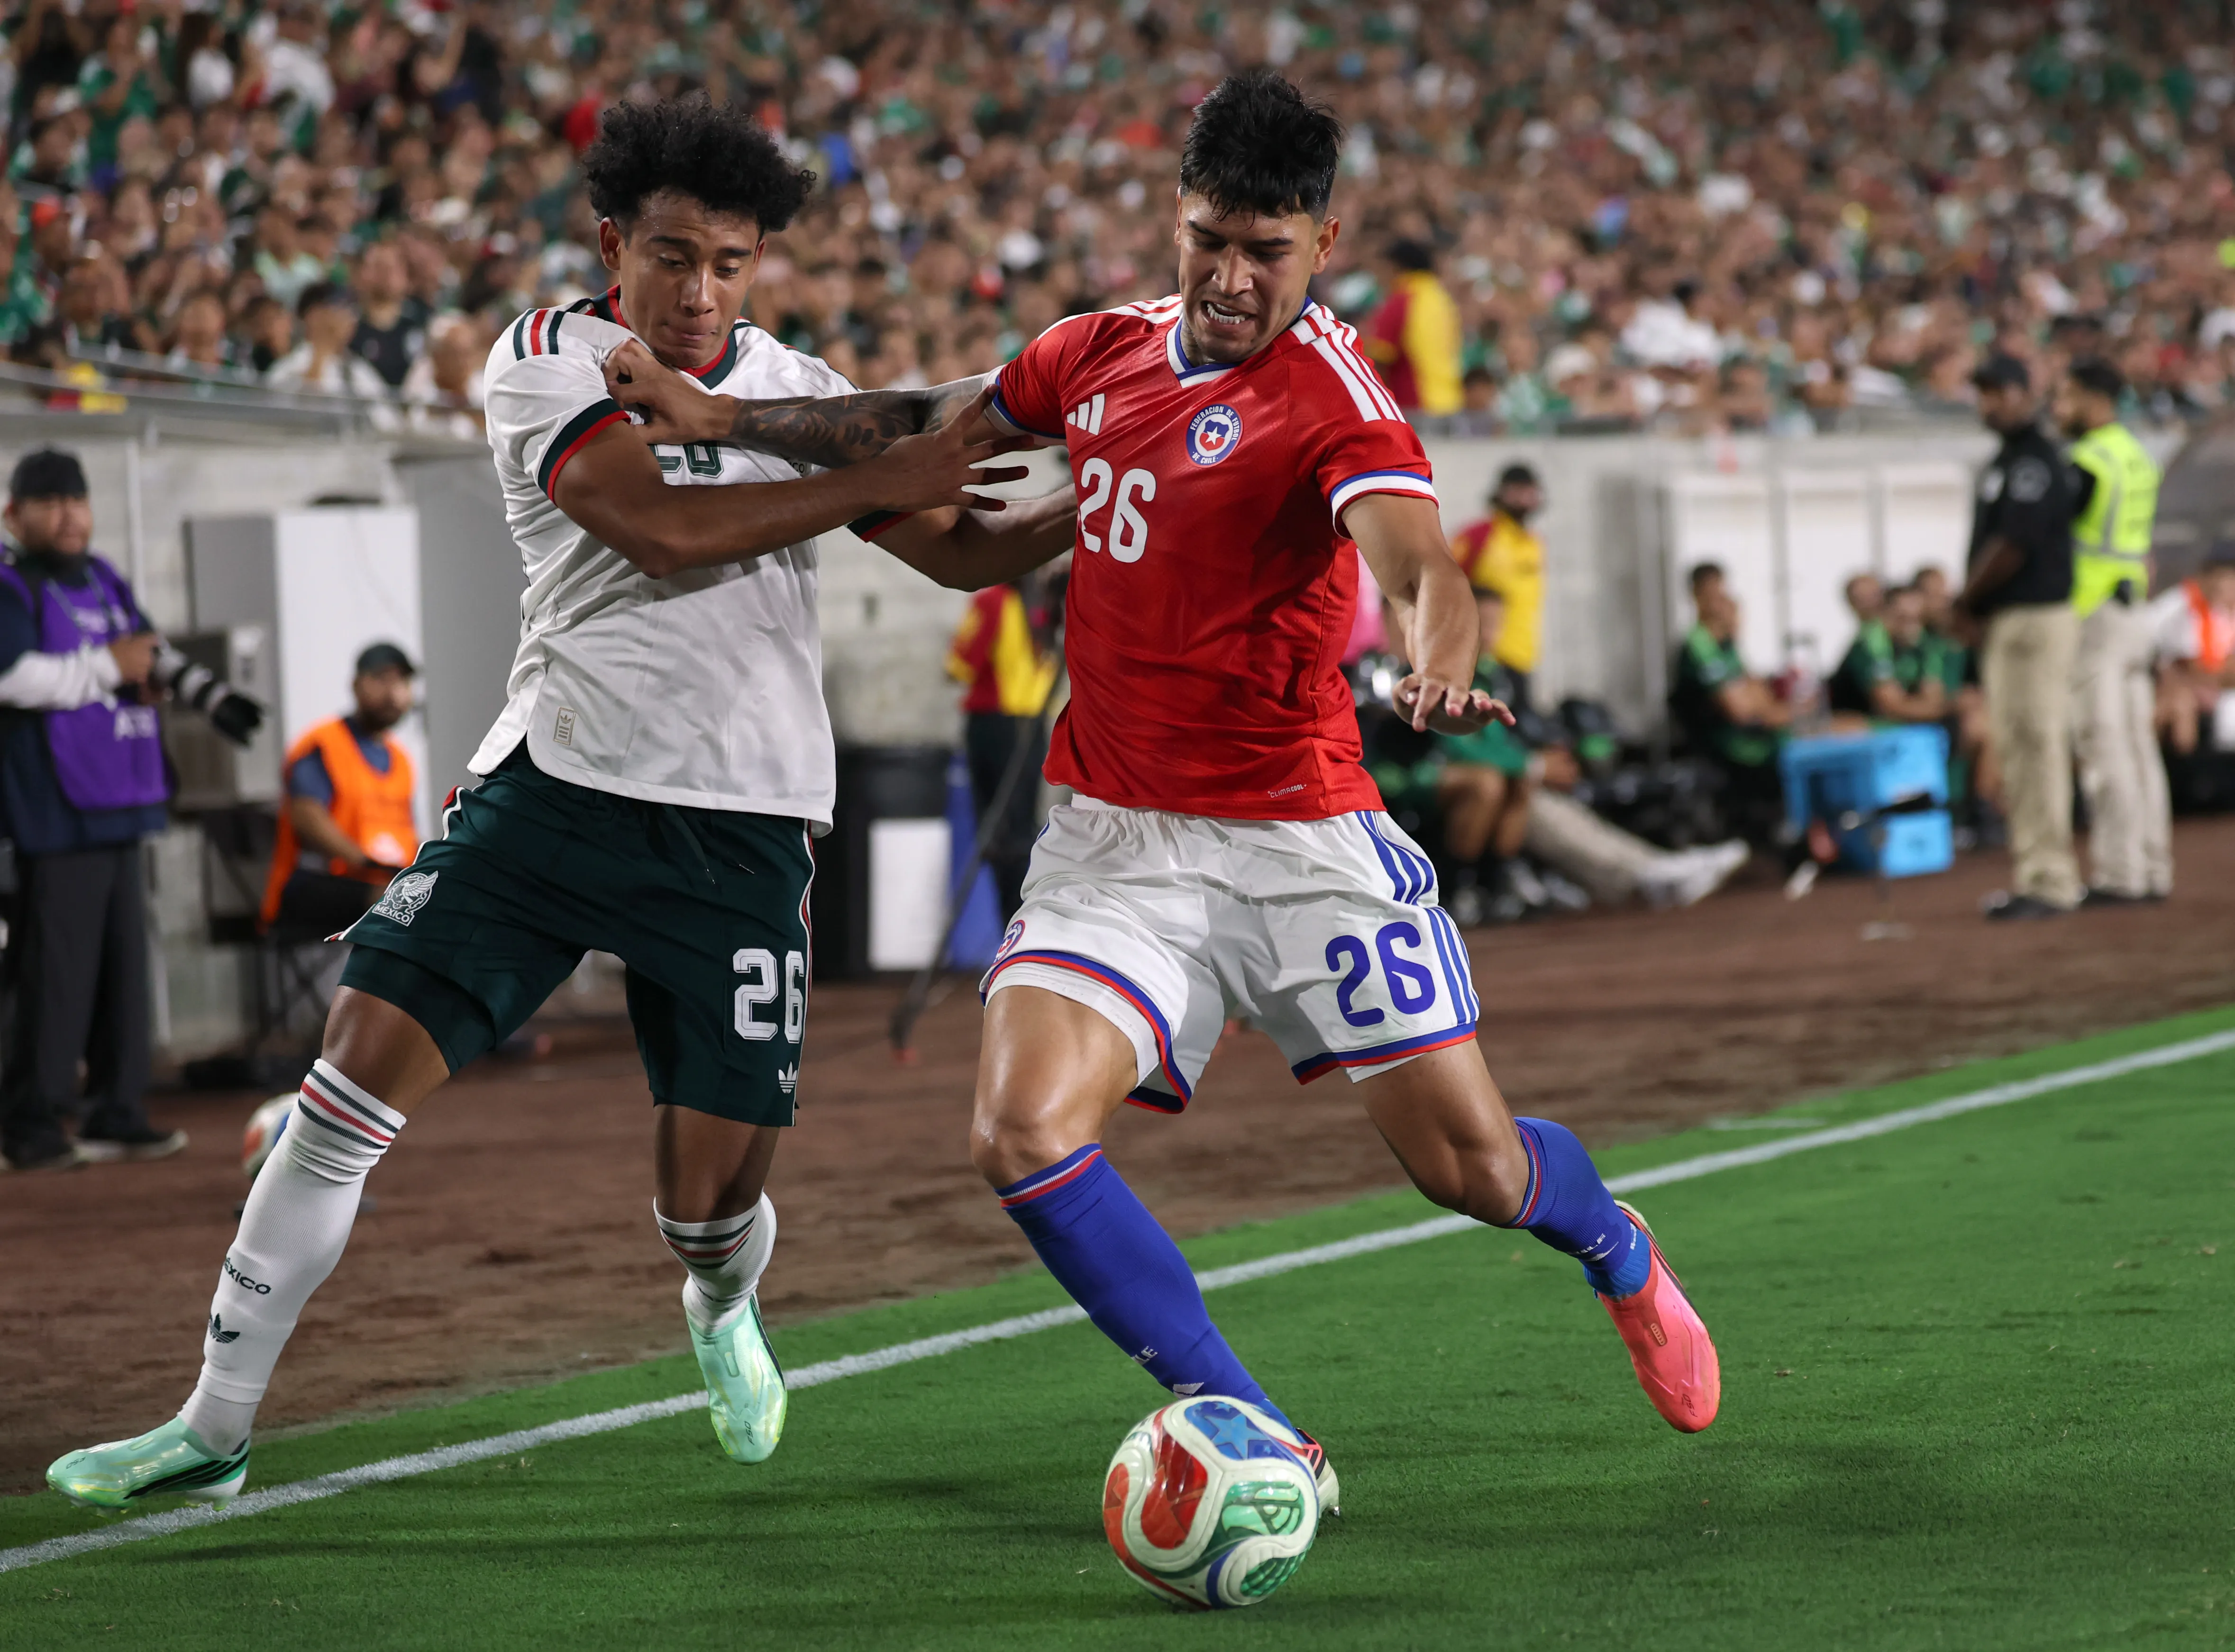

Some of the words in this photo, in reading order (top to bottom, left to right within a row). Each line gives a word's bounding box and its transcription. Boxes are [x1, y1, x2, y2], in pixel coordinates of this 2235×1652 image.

[1190, 406, 1224, 431] FEDERACION
[1226, 408, 1234, 418] DE
[1231, 417, 1240, 441] FUTBOL
[1192, 452, 1201, 461] DE
[1200, 456, 1216, 464] CHILE
[1078, 457, 1157, 563] 26
[1270, 784, 1305, 798] CLIMACOOL
[374, 905, 410, 923] MÉXICO
[1325, 921, 1436, 1027] 26
[732, 948, 805, 1044] 26
